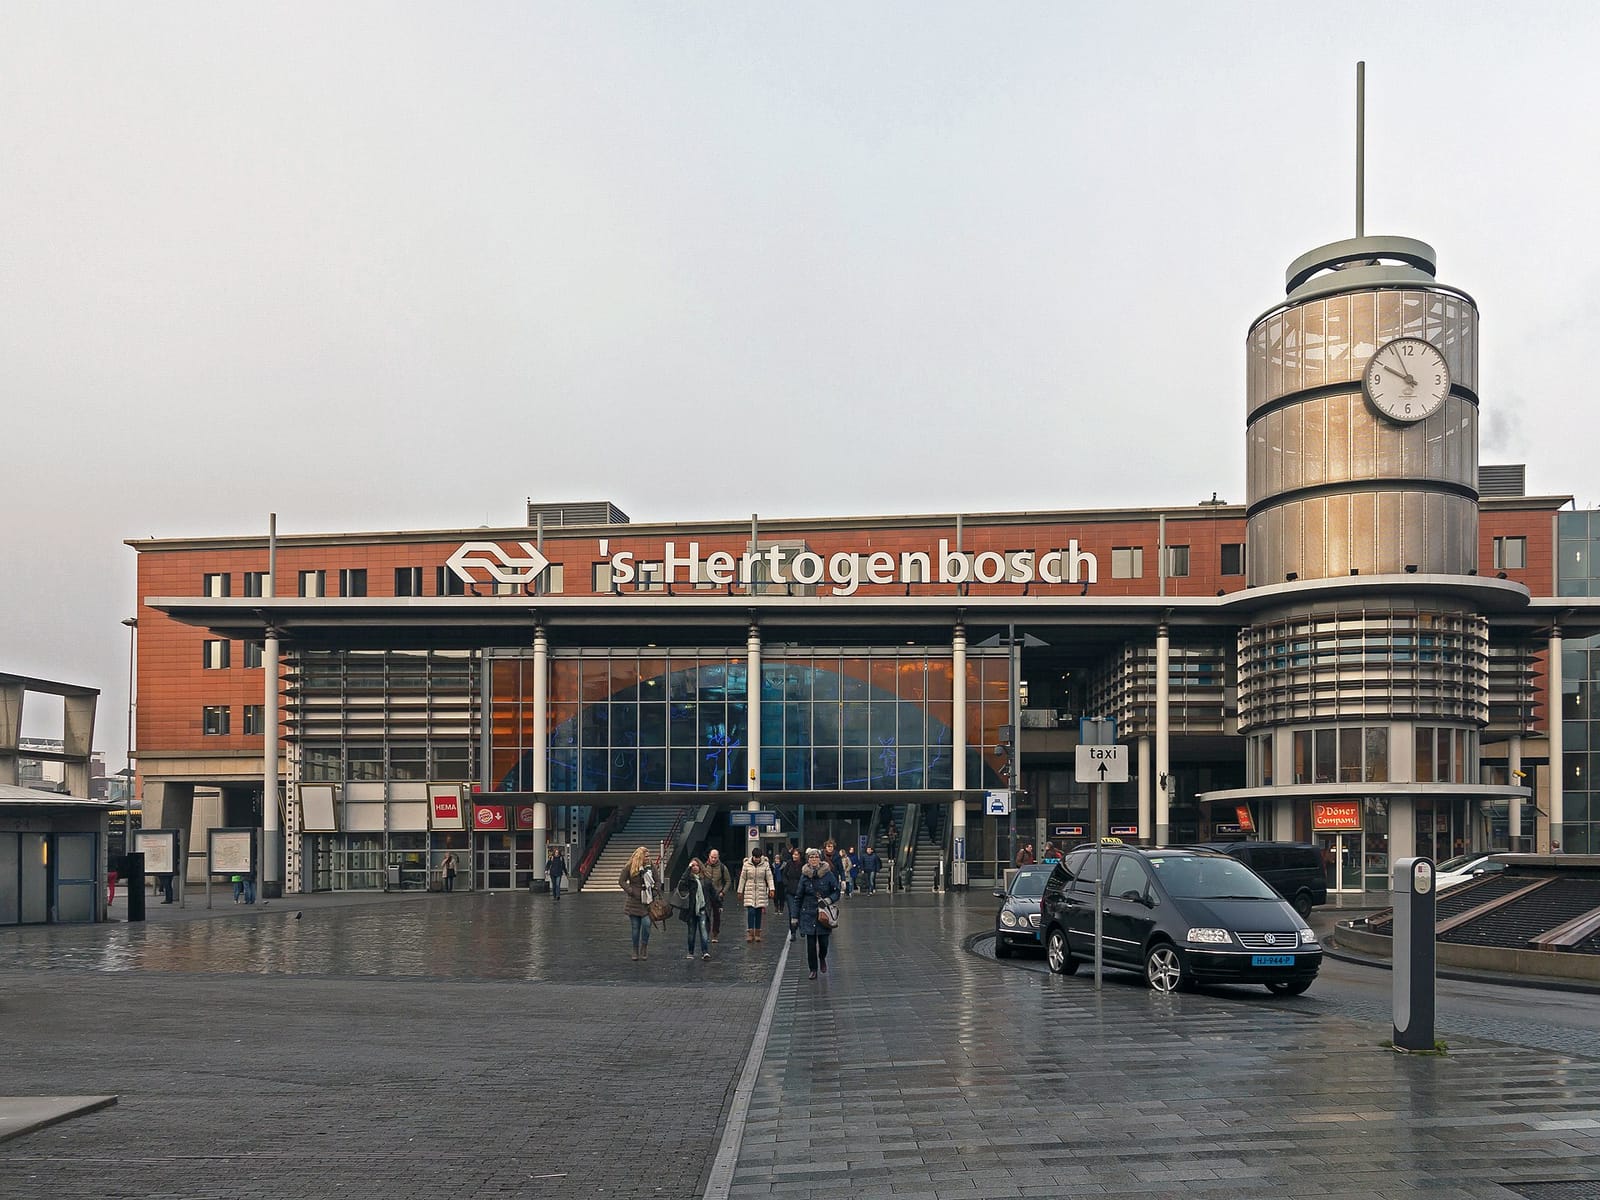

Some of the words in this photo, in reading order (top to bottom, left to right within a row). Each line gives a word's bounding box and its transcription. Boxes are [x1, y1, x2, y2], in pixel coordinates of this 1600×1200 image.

[1402, 345, 1414, 357] 12
[1374, 374, 1381, 385] 9
[1434, 374, 1442, 386] 3
[1404, 403, 1411, 414] 6
[599, 538, 1098, 596] 's-Hertogenbosch
[1089, 746, 1117, 759] taxi
[1326, 806, 1356, 816] Döner
[1317, 816, 1357, 826] Company
